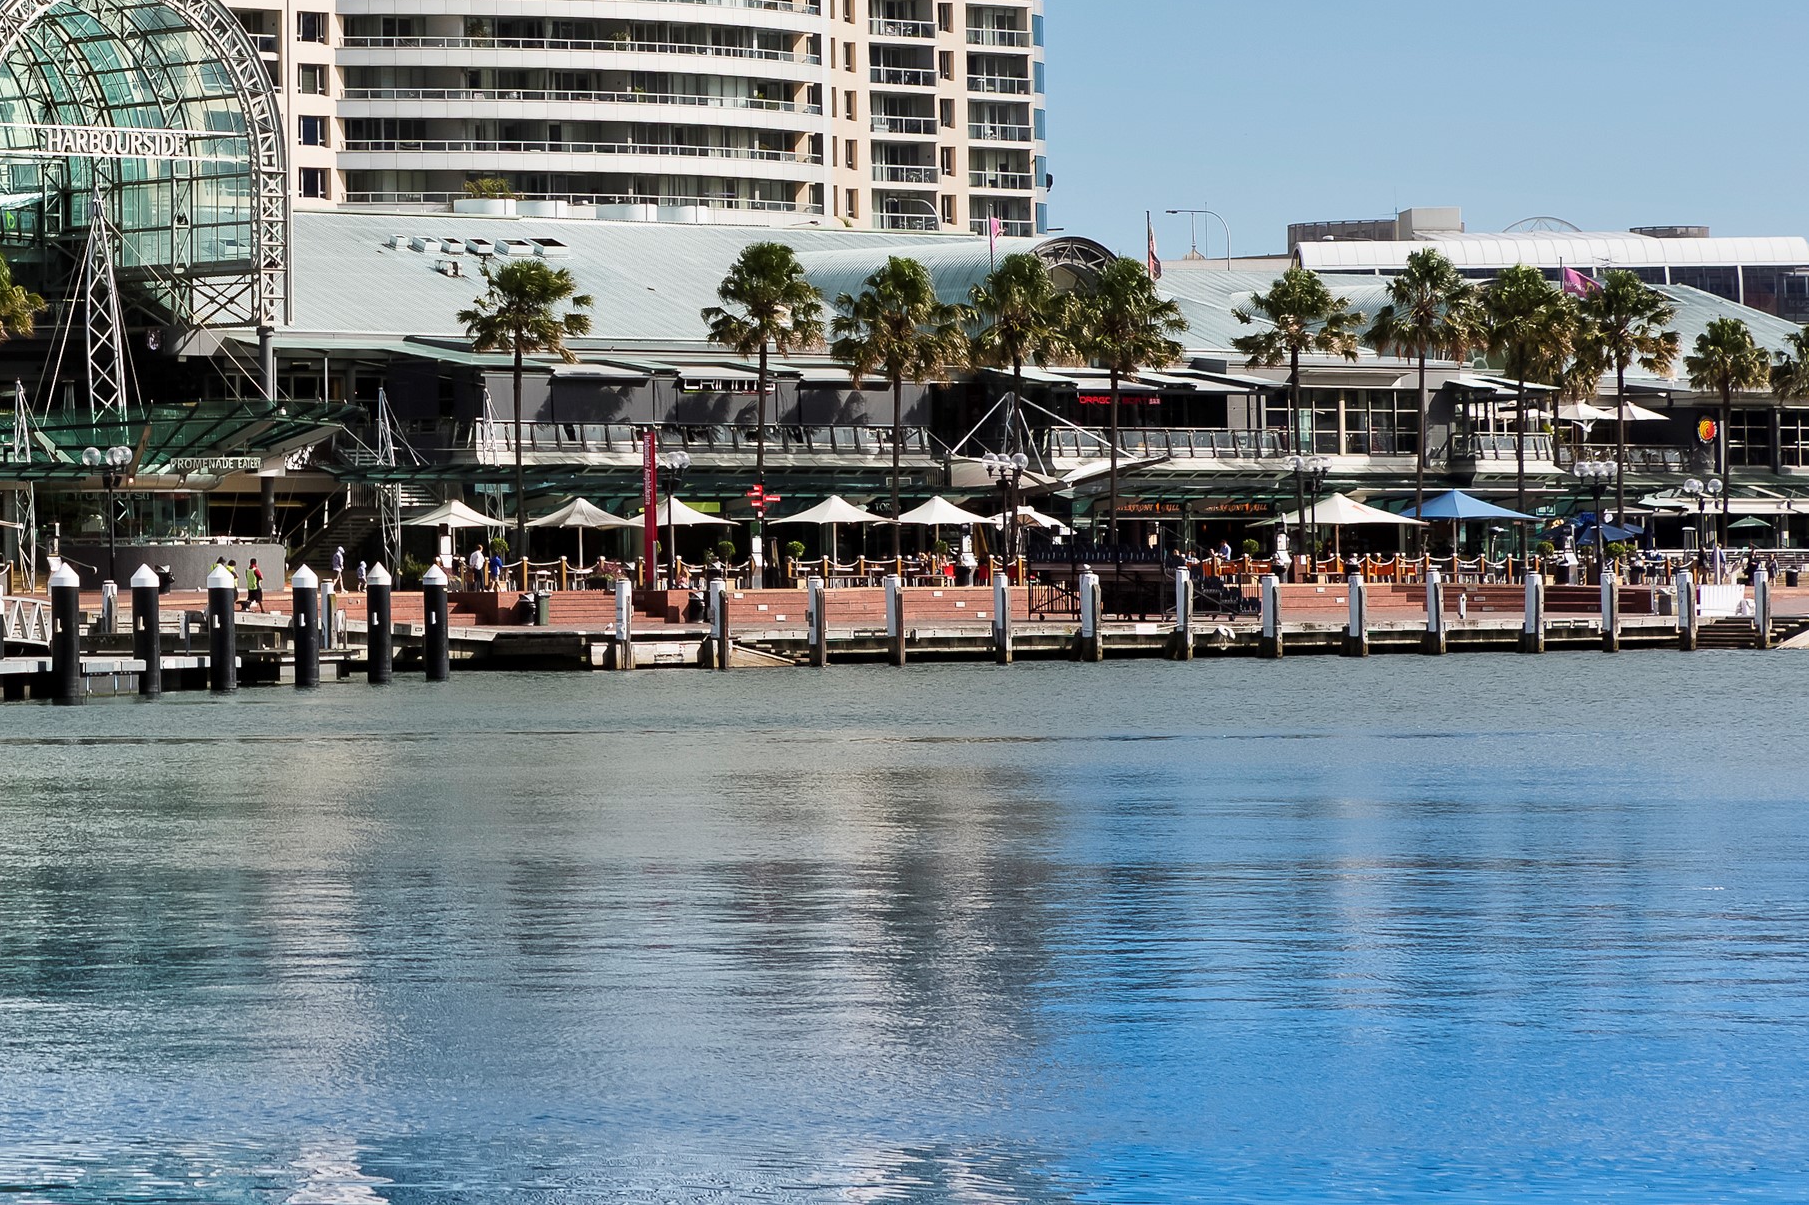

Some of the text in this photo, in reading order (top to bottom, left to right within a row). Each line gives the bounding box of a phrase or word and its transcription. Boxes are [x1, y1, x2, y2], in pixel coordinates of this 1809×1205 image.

[46, 128, 187, 157] HARBOURSIDE
[171, 458, 261, 469] PROMENADE EATERY
